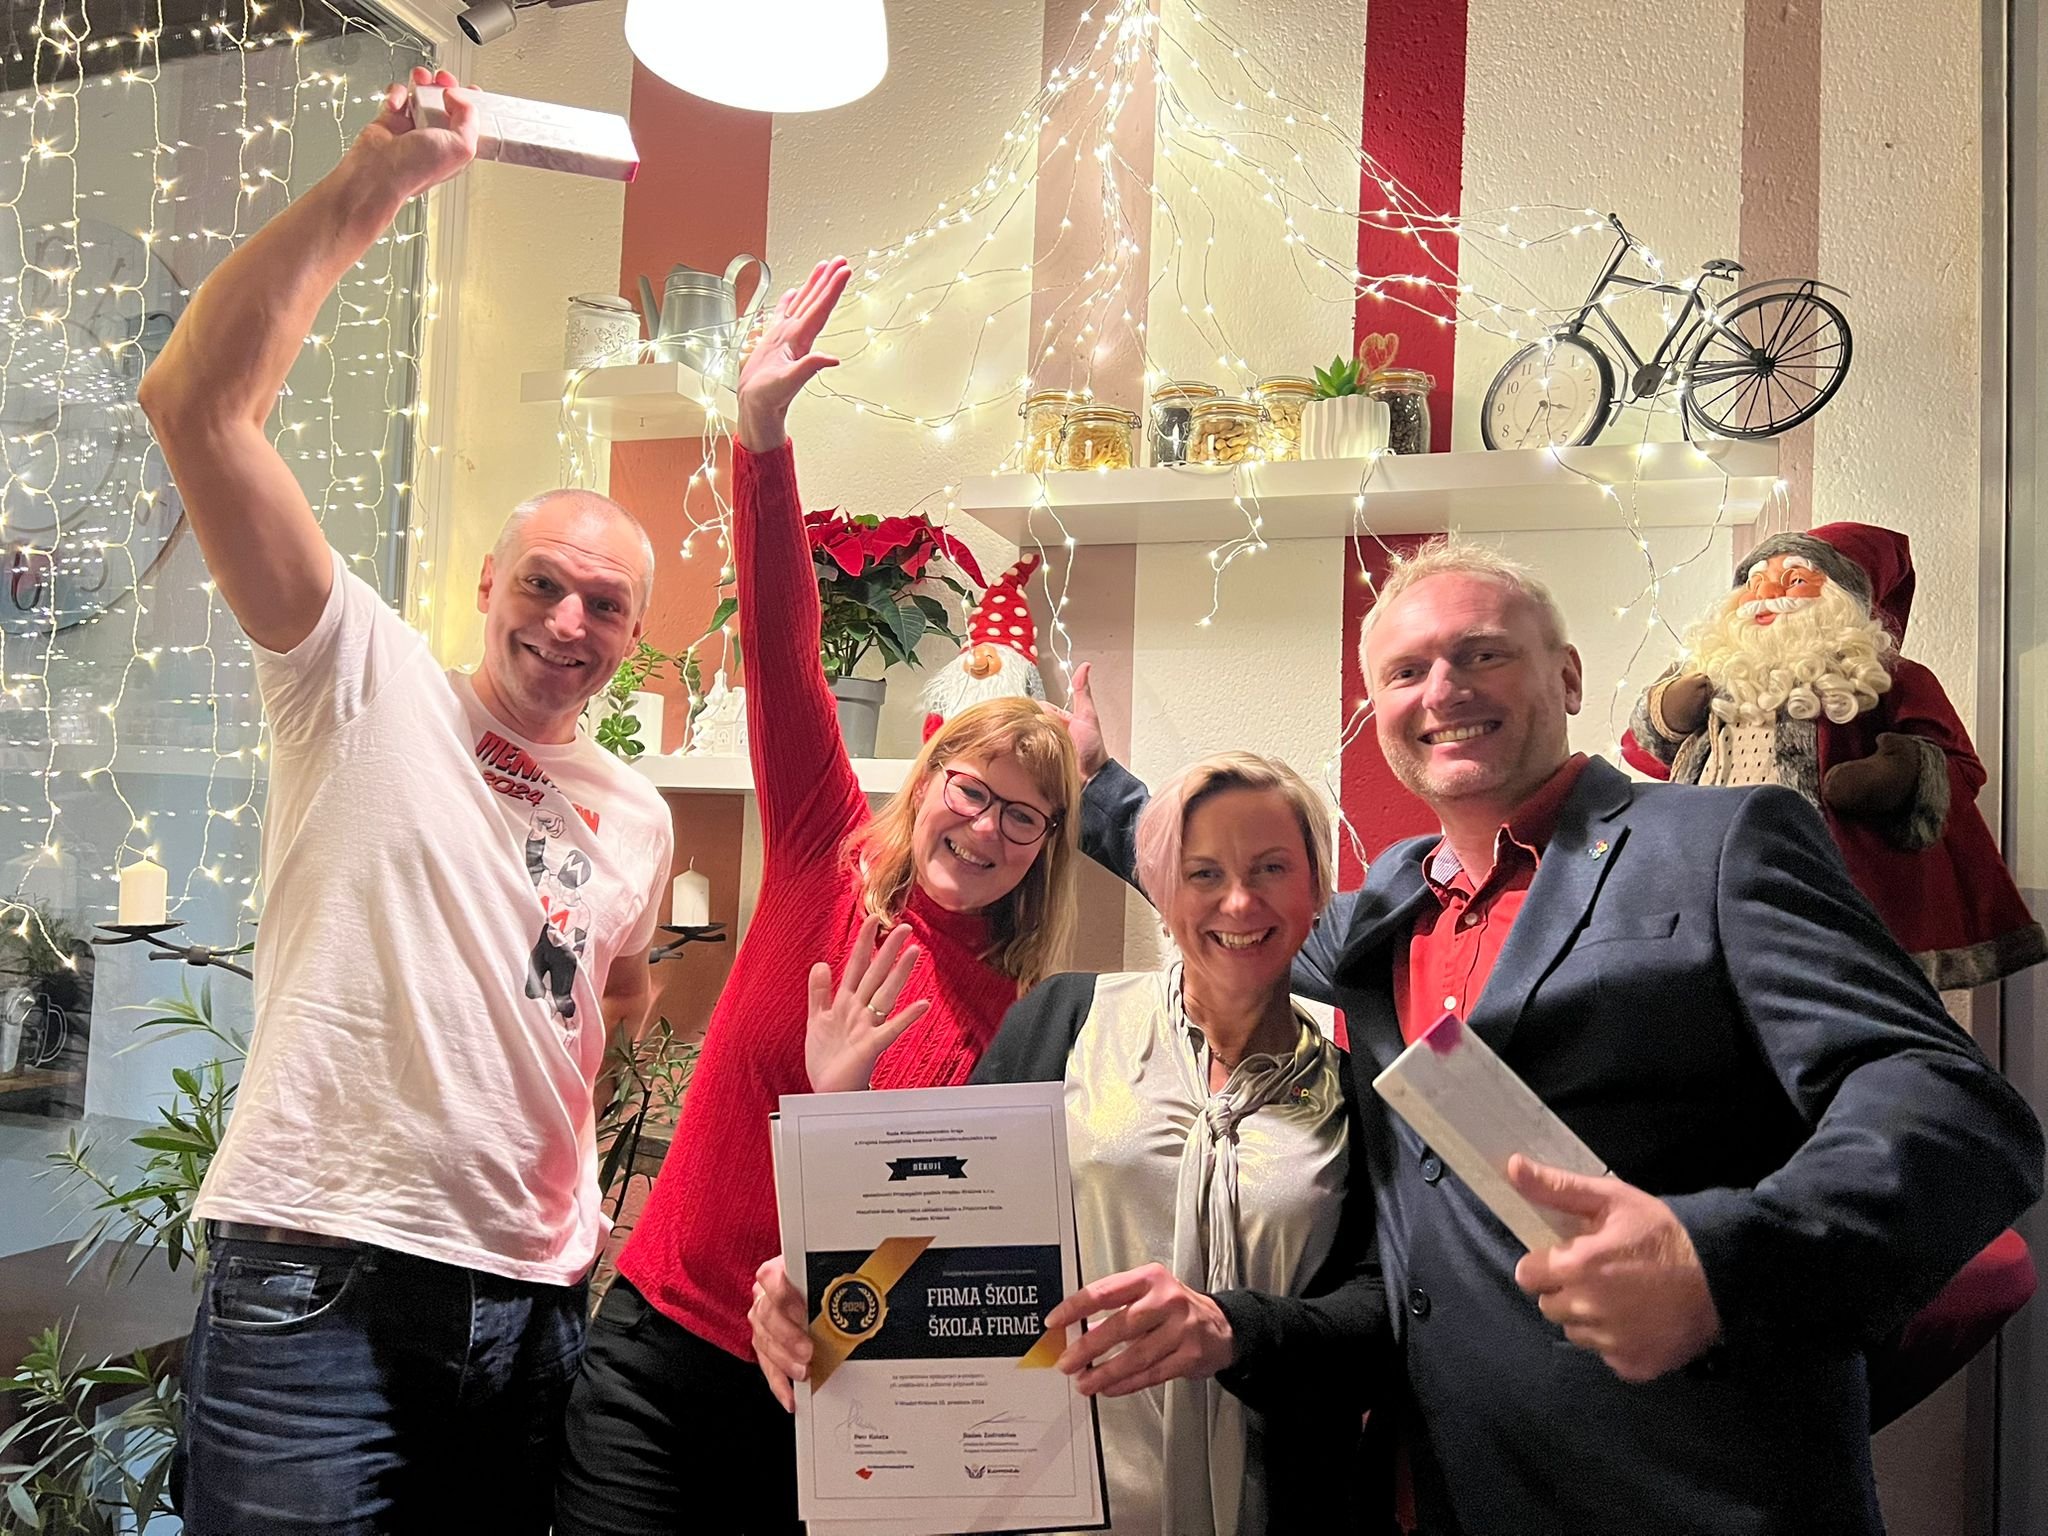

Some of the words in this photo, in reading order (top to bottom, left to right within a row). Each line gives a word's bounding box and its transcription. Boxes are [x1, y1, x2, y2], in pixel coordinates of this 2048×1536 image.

[1506, 381, 1519, 395] 10
[1497, 402, 1505, 416] 9
[1502, 424, 1510, 438] 8
[483, 769, 545, 807] 2024
[927, 1286, 981, 1307] FIRMA
[985, 1283, 1038, 1305] ŠKOLE
[928, 1314, 983, 1337] ŠKOLA
[986, 1312, 1040, 1336] FIRMĚ
